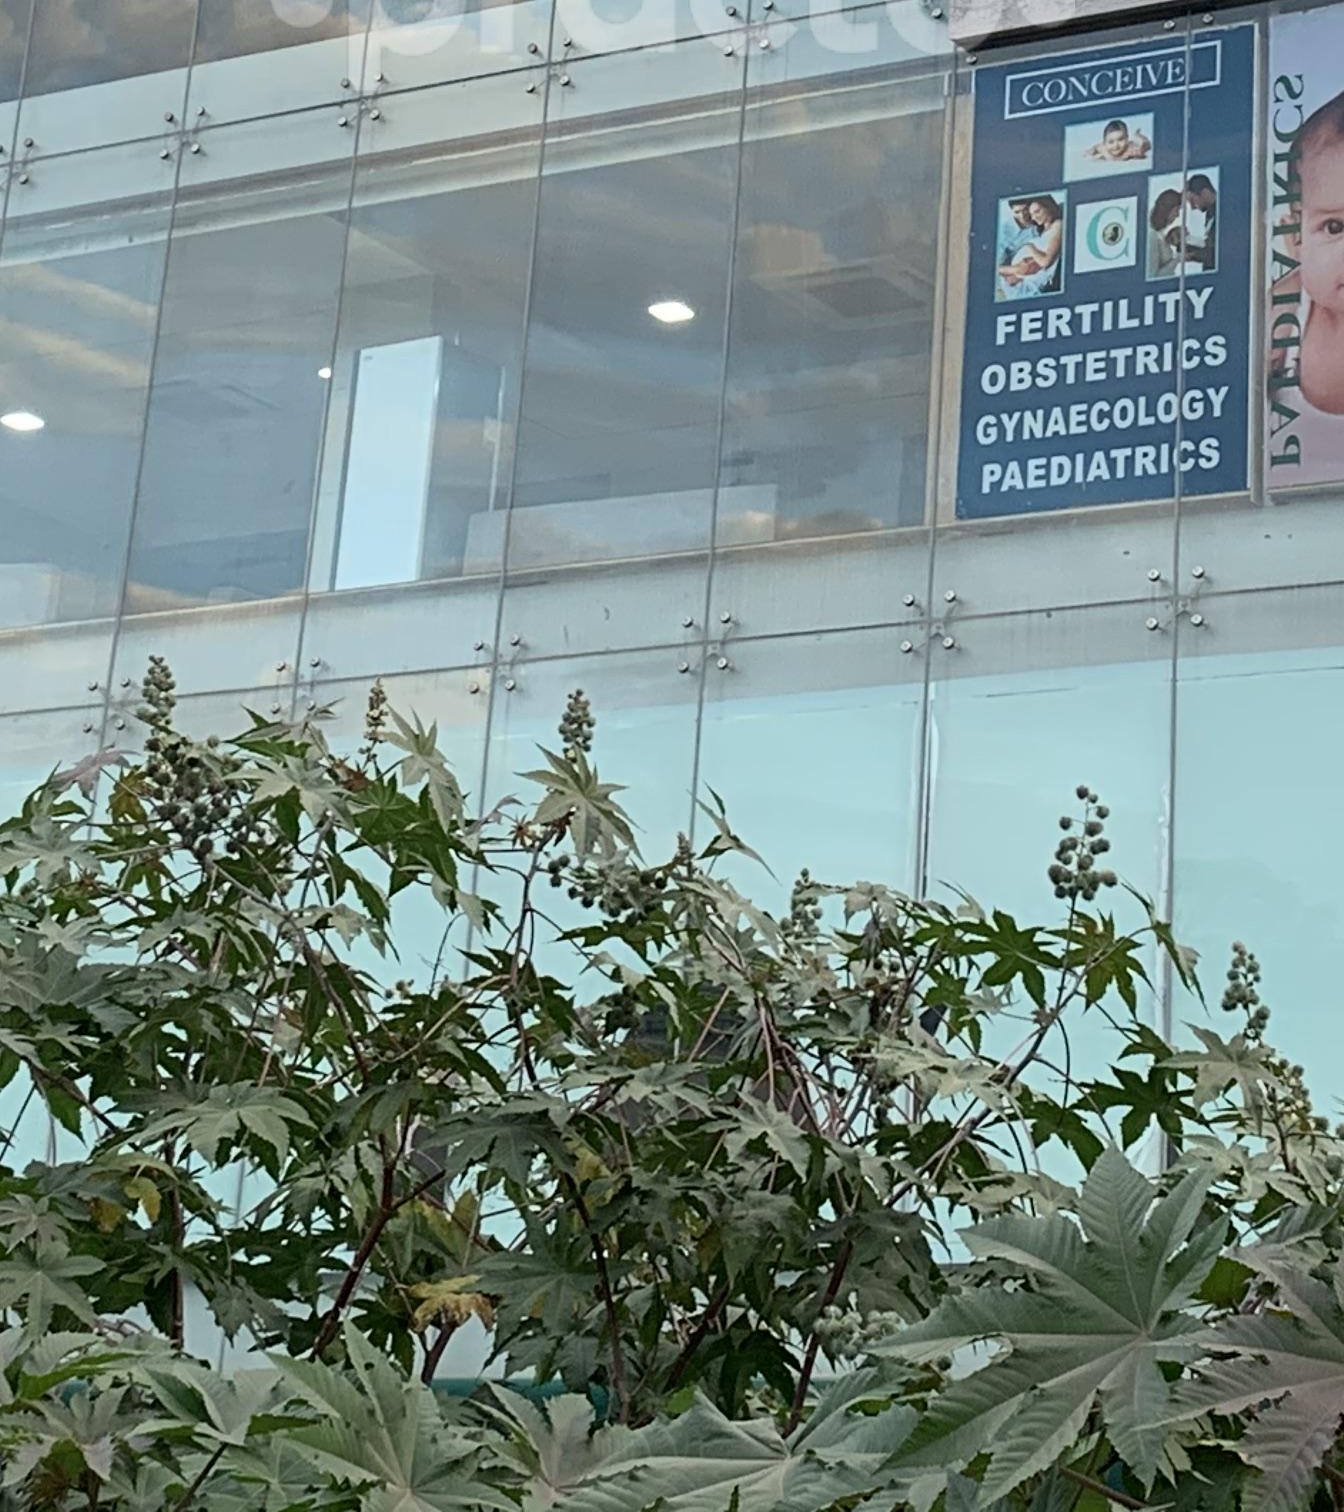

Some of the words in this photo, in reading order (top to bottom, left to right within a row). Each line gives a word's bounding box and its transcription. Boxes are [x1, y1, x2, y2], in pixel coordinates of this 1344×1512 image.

[1021, 56, 1187, 108] CONCEIVE
[994, 286, 1214, 346] FERTILITY
[980, 334, 1228, 396] OBSTETRICS
[975, 385, 1230, 446] GYNAECOLOGY
[980, 436, 1221, 494] PAEDIATRICS
